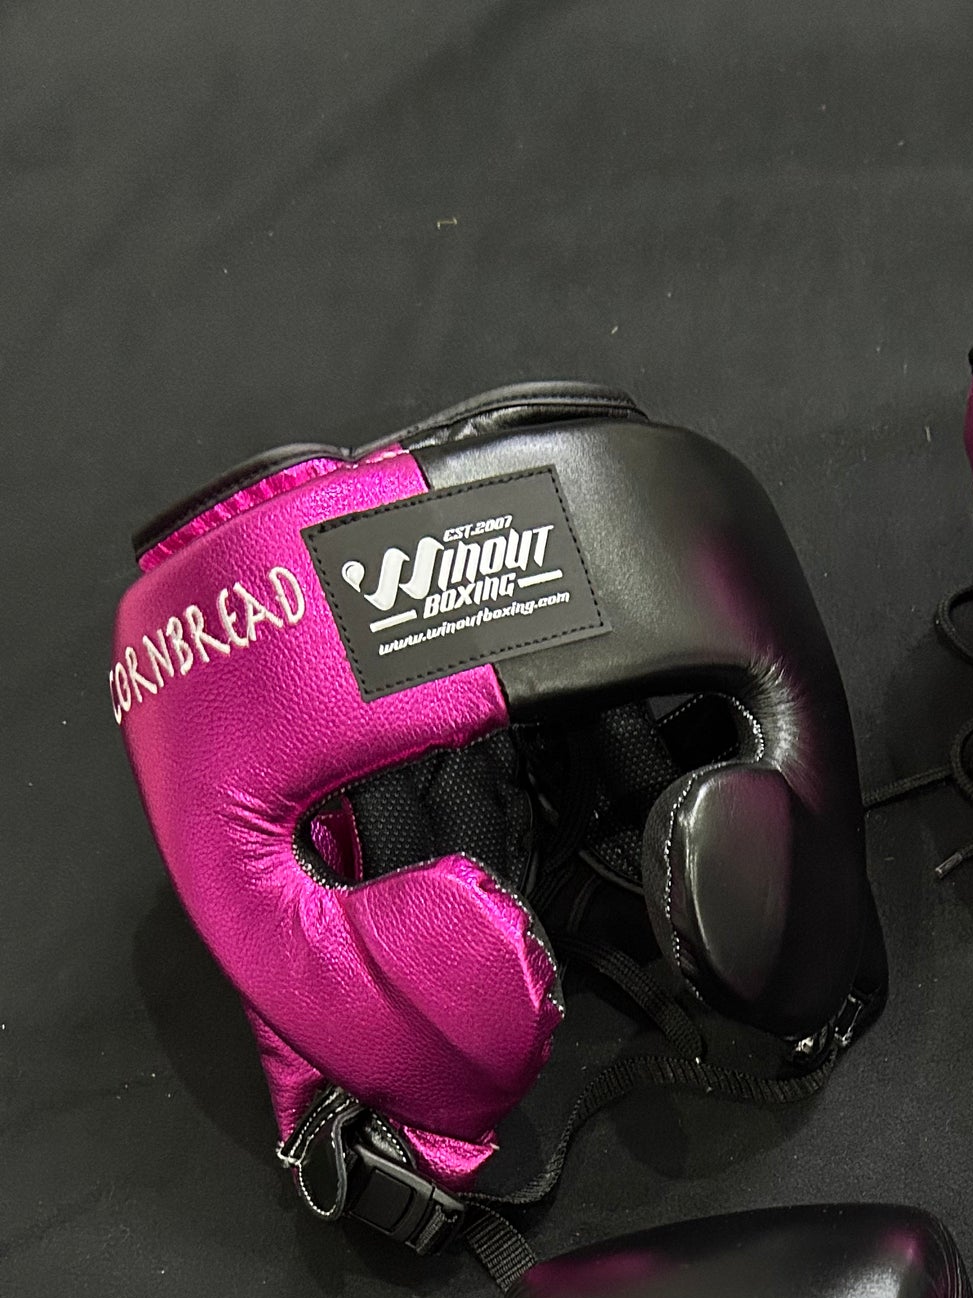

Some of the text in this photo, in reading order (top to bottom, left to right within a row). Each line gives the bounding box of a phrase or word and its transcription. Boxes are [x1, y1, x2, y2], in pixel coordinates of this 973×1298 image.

[443, 514, 513, 542] EST.2007
[378, 591, 570, 656] www.winoutboxing.com
[423, 572, 516, 619] BOXING
[109, 566, 306, 725] CORNBREAD
